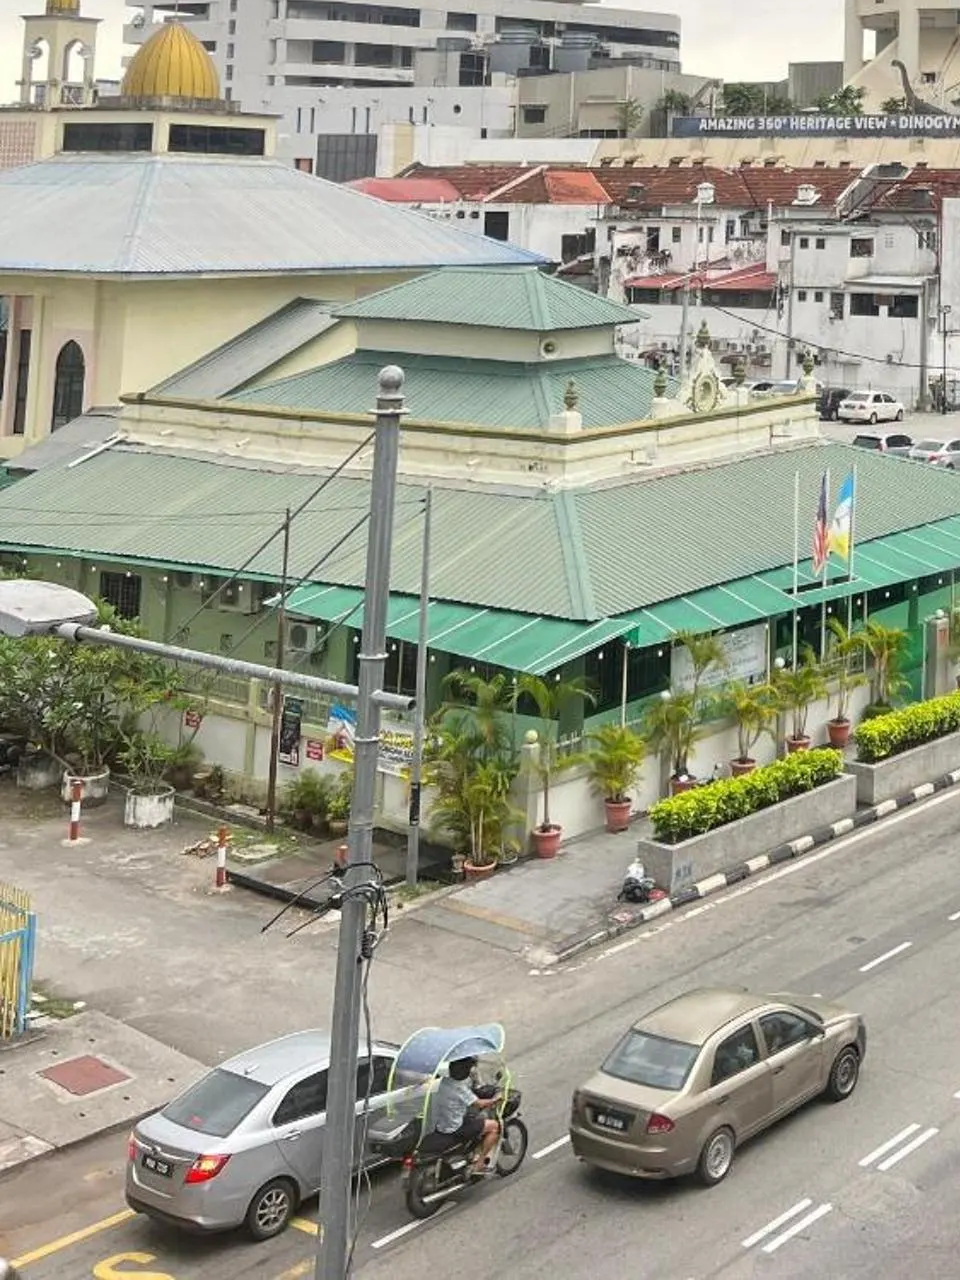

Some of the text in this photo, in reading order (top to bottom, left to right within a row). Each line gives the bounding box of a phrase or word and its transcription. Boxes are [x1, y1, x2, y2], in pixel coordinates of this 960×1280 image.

[699, 117, 754, 131] AMAZING
[790, 116, 851, 130] HERITAGE
[854, 116, 888, 130] VIEW
